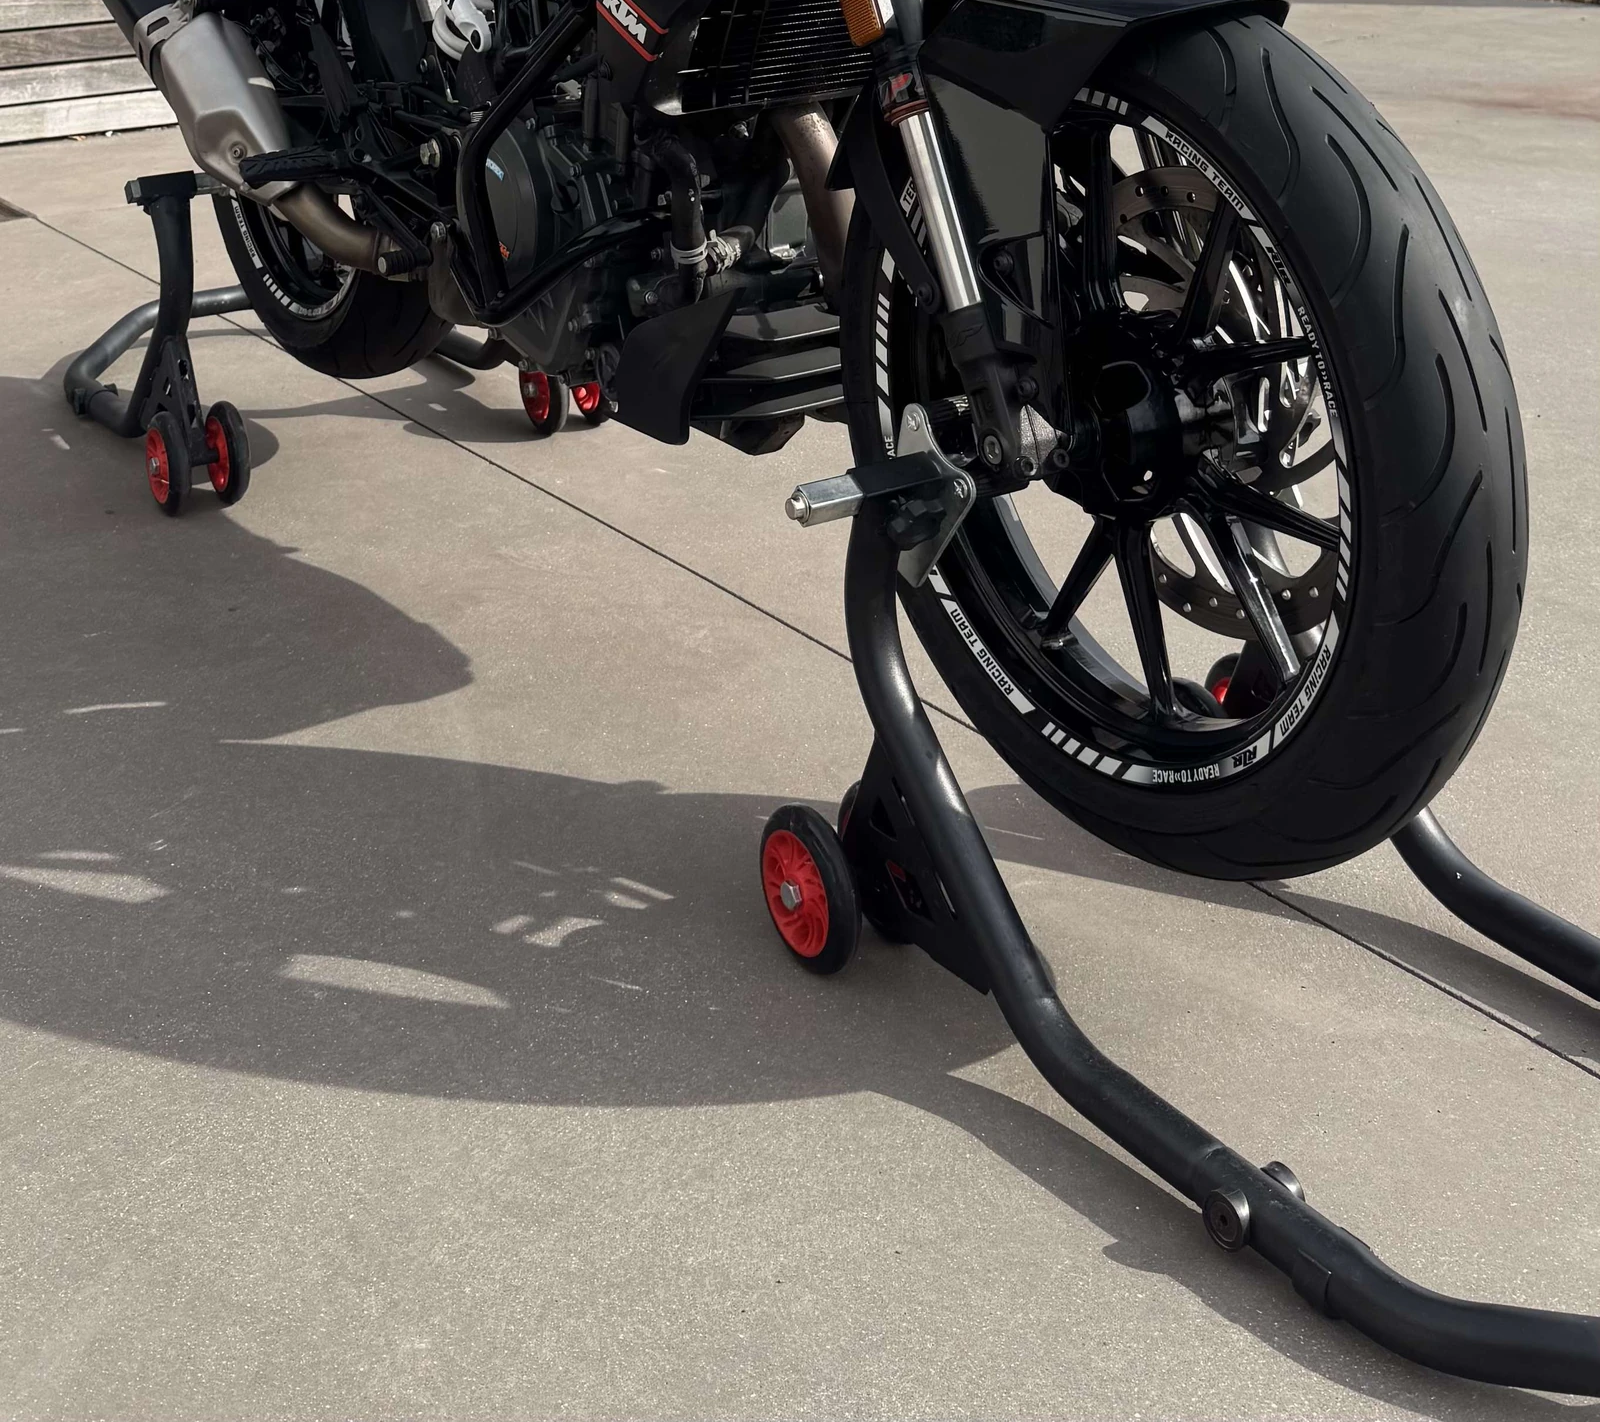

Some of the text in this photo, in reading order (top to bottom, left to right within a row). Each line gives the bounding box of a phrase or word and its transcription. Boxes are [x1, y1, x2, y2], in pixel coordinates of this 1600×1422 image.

[1165, 130, 1244, 211] RACING TEAM
[1297, 306, 1338, 418] READY TO RACE
[885, 435, 896, 460] ACE
[950, 608, 1014, 696] RACING TEAM
[1280, 645, 1332, 736] RACING TEAM
[1152, 763, 1220, 784] READY TO RACE
